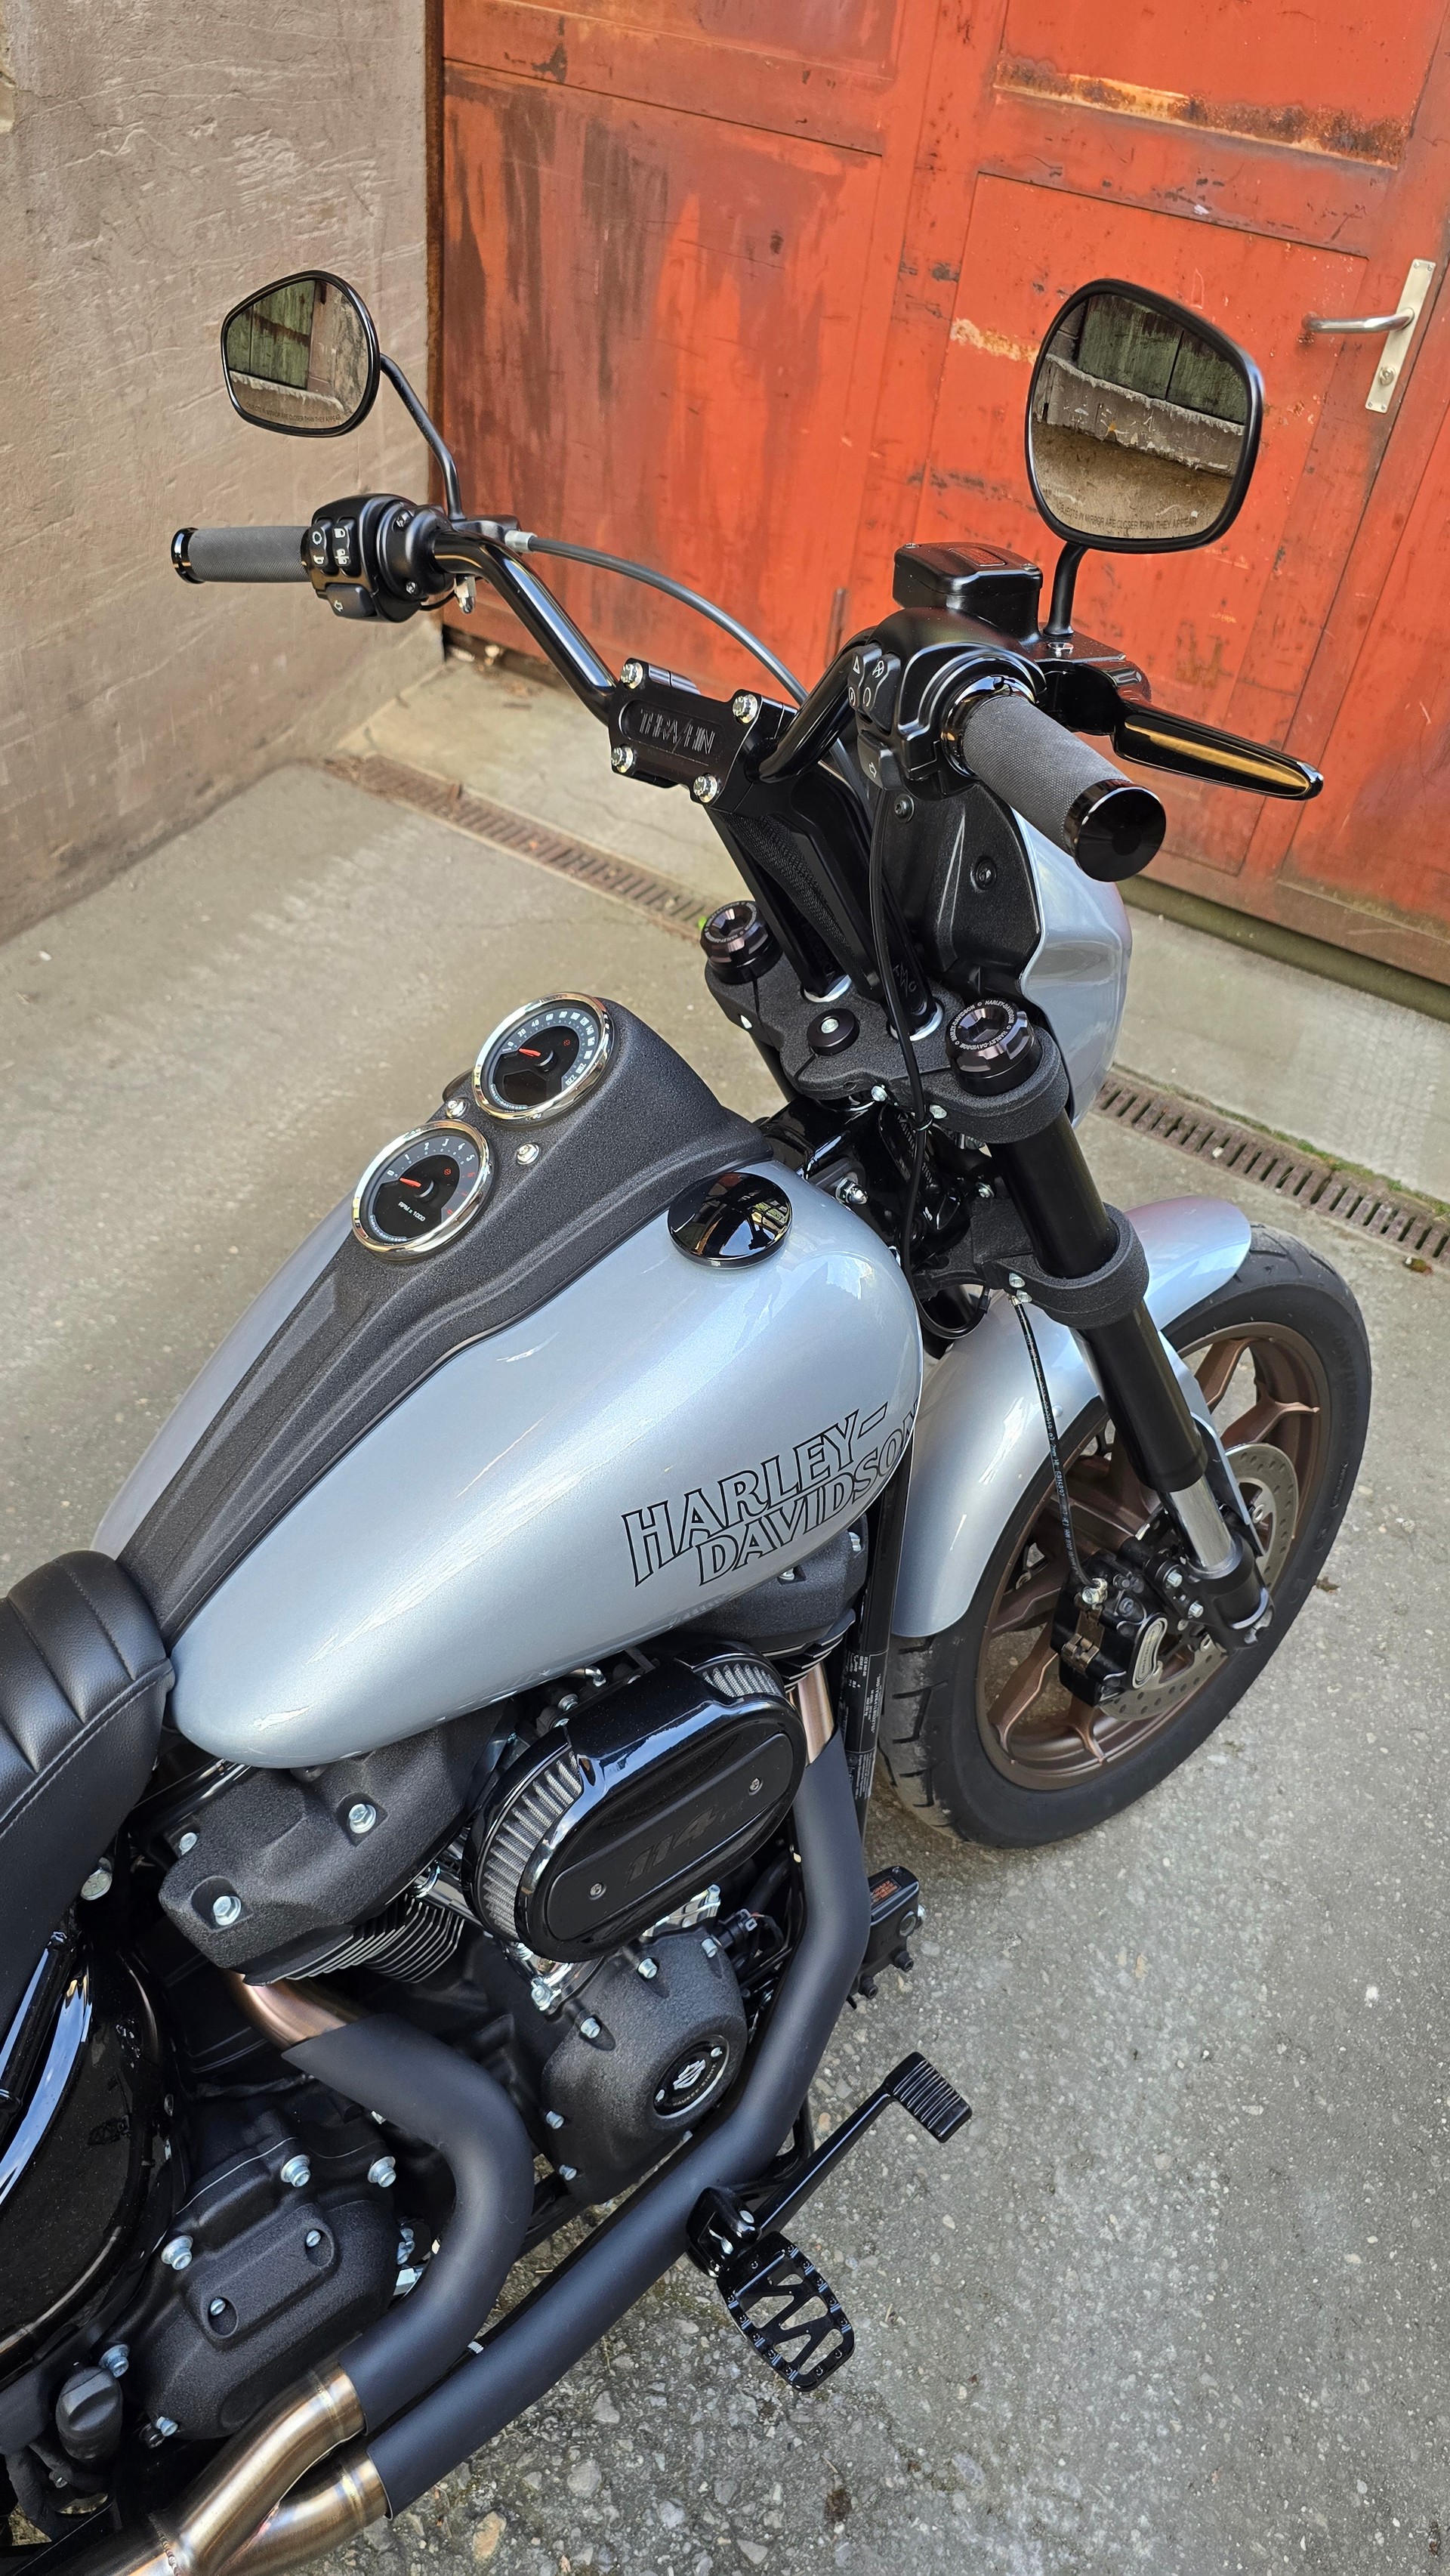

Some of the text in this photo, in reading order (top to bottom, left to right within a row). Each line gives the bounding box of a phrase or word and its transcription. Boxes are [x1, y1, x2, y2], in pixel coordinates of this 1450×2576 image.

[325, 414, 341, 422] APPEAR
[1105, 518, 1116, 528] ARE
[1117, 519, 1138, 530] CLOSER
[1139, 520, 1155, 530] THAN
[1155, 520, 1171, 530] THEY
[1172, 517, 1197, 528] APPEAR
[985, 999, 1015, 1024] HARLEY-DAVIDSON
[531, 1019, 539, 1027] 40
[950, 1004, 976, 1042] HARLEY-DAVIDSON
[517, 1028, 526, 1037] 20
[959, 1030, 1008, 1051] HARLEY-DAVIDSON
[575, 1063, 587, 1074] 200
[565, 1074, 578, 1086] 220
[424, 1141, 430, 1151] 2
[442, 1138, 449, 1147] 3
[458, 1142, 465, 1151] 4
[398, 1201, 410, 1212] RPM
[413, 1211, 427, 1222] 1000
[621, 1401, 888, 1587] HARLEY-
[625, 1806, 719, 1888] 114
